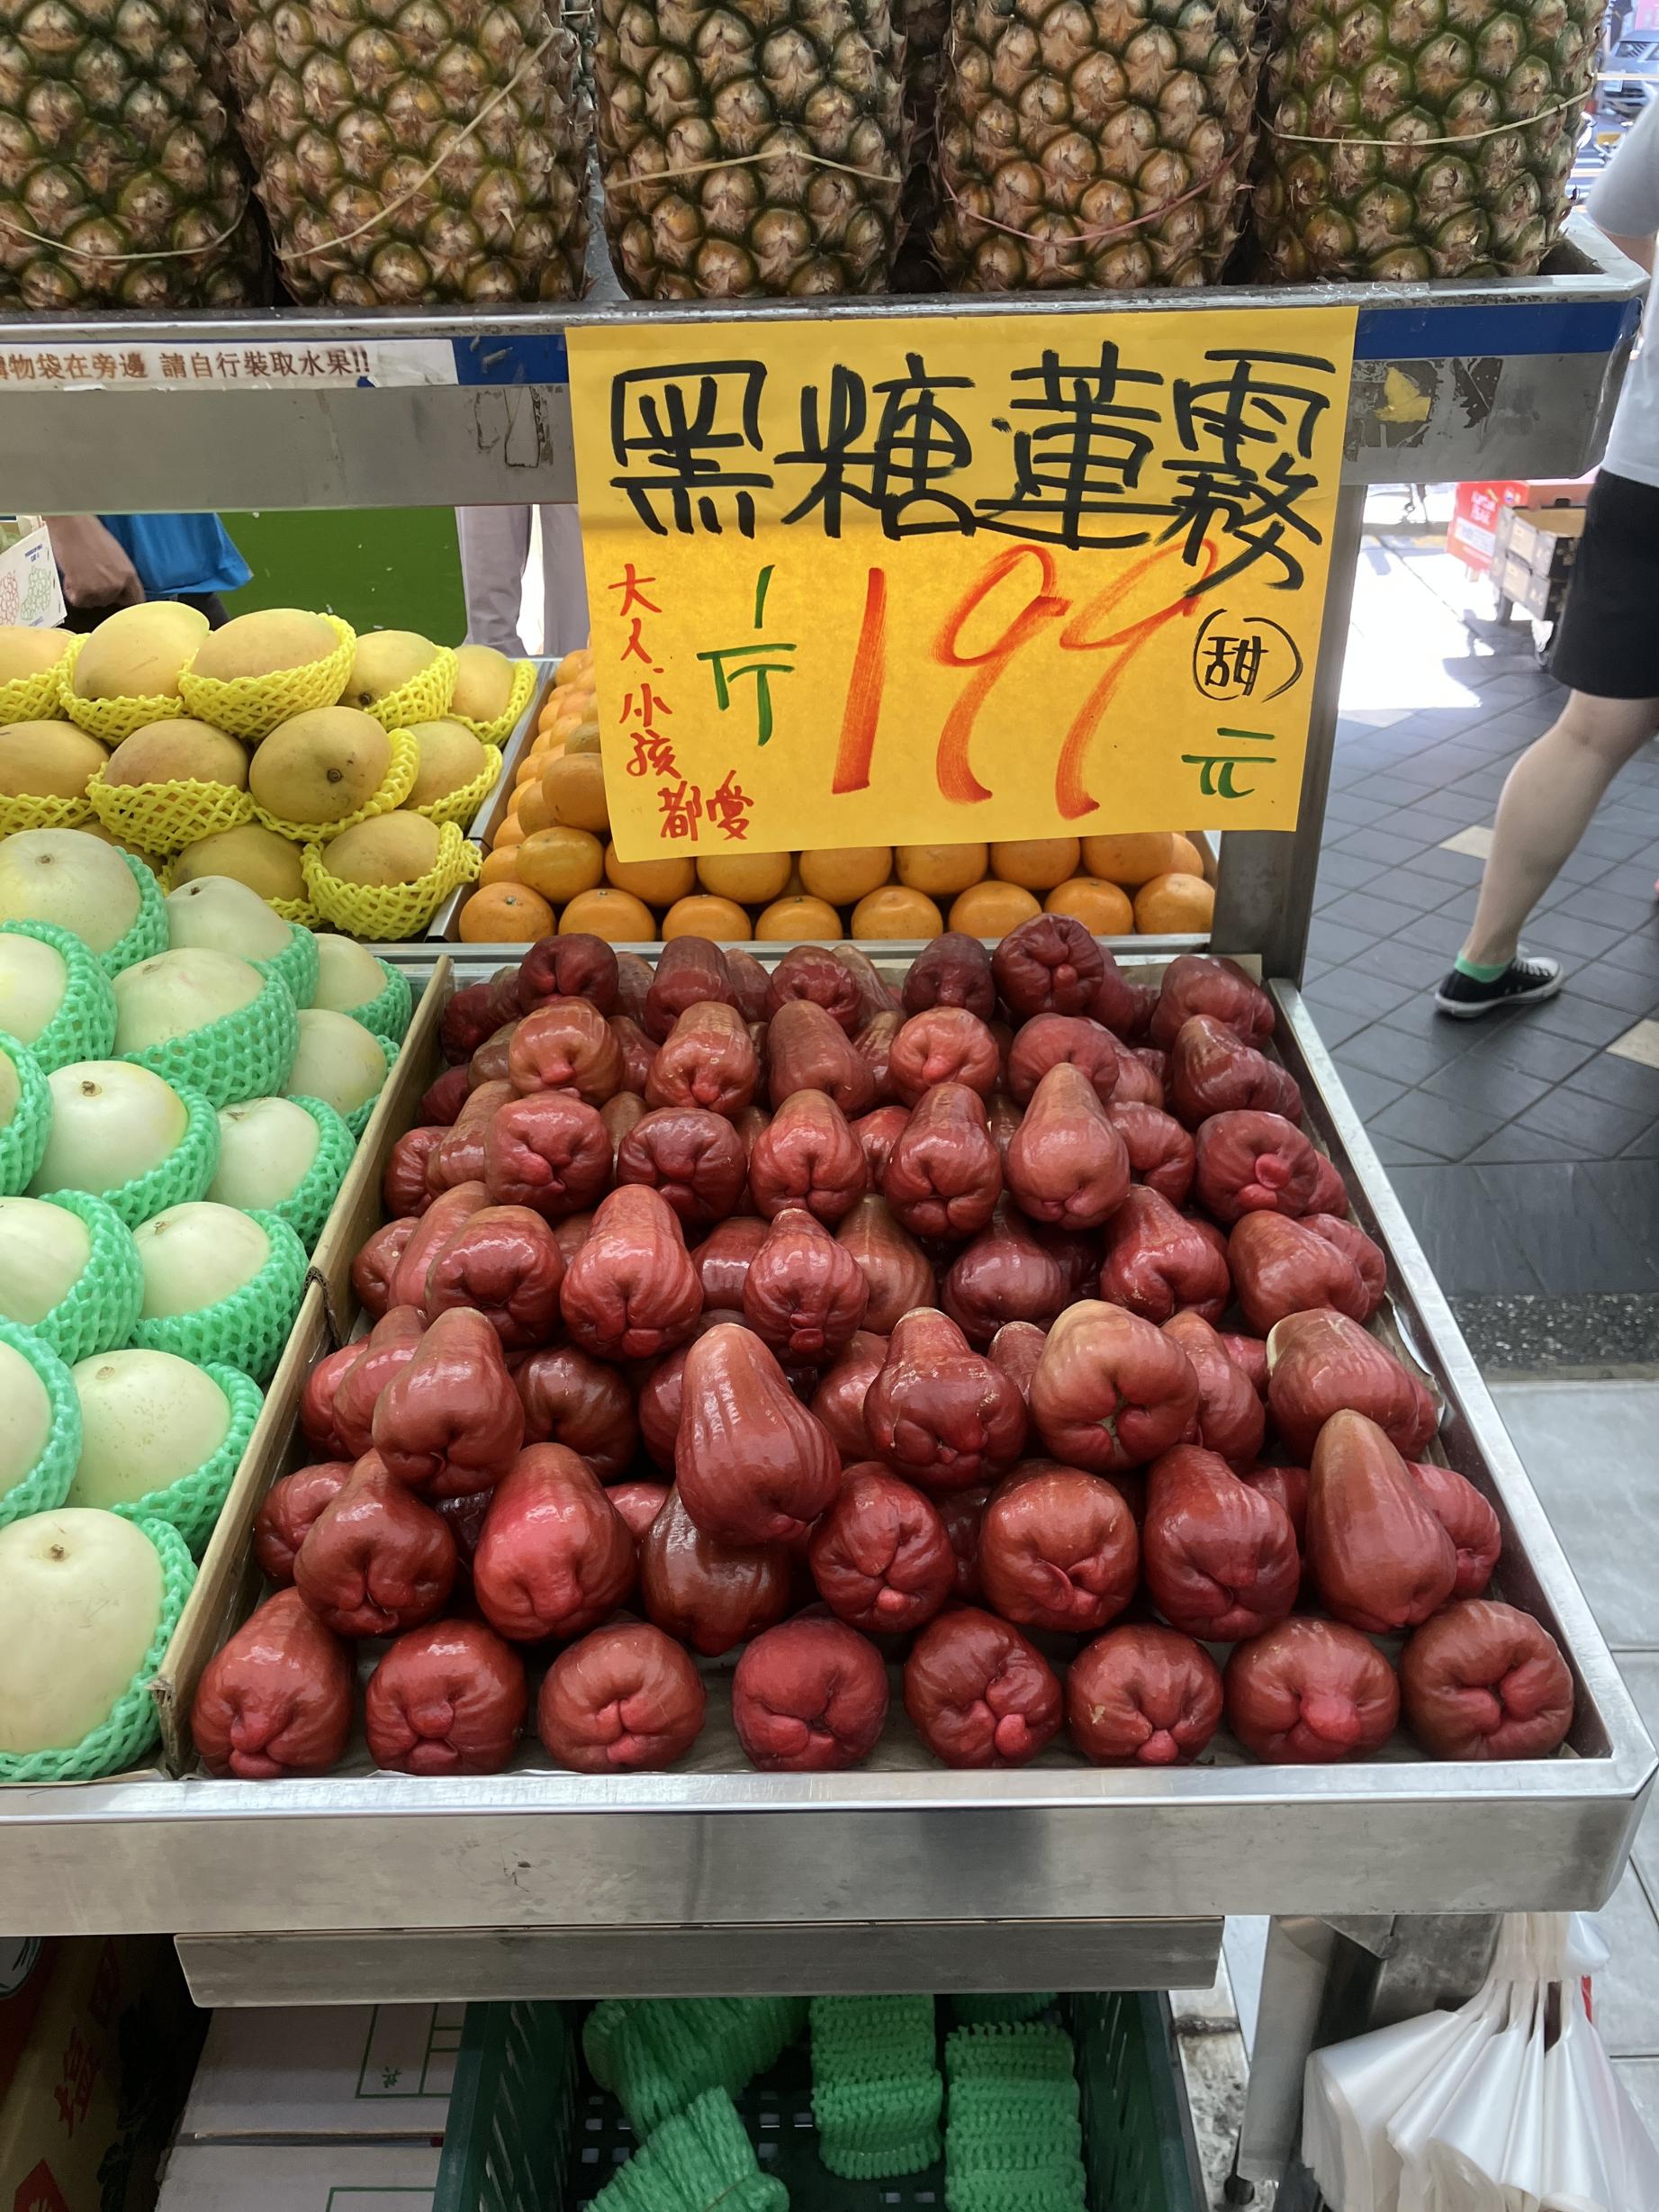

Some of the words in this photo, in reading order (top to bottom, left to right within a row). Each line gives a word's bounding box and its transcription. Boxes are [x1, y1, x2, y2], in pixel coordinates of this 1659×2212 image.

[0, 352, 147, 380] 物袋在旁邊
[609, 339, 1338, 596] 黑糖蓮霧
[832, 540, 1219, 820] 199
[1202, 635, 1270, 696] 甜
[1181, 727, 1277, 799] 元
